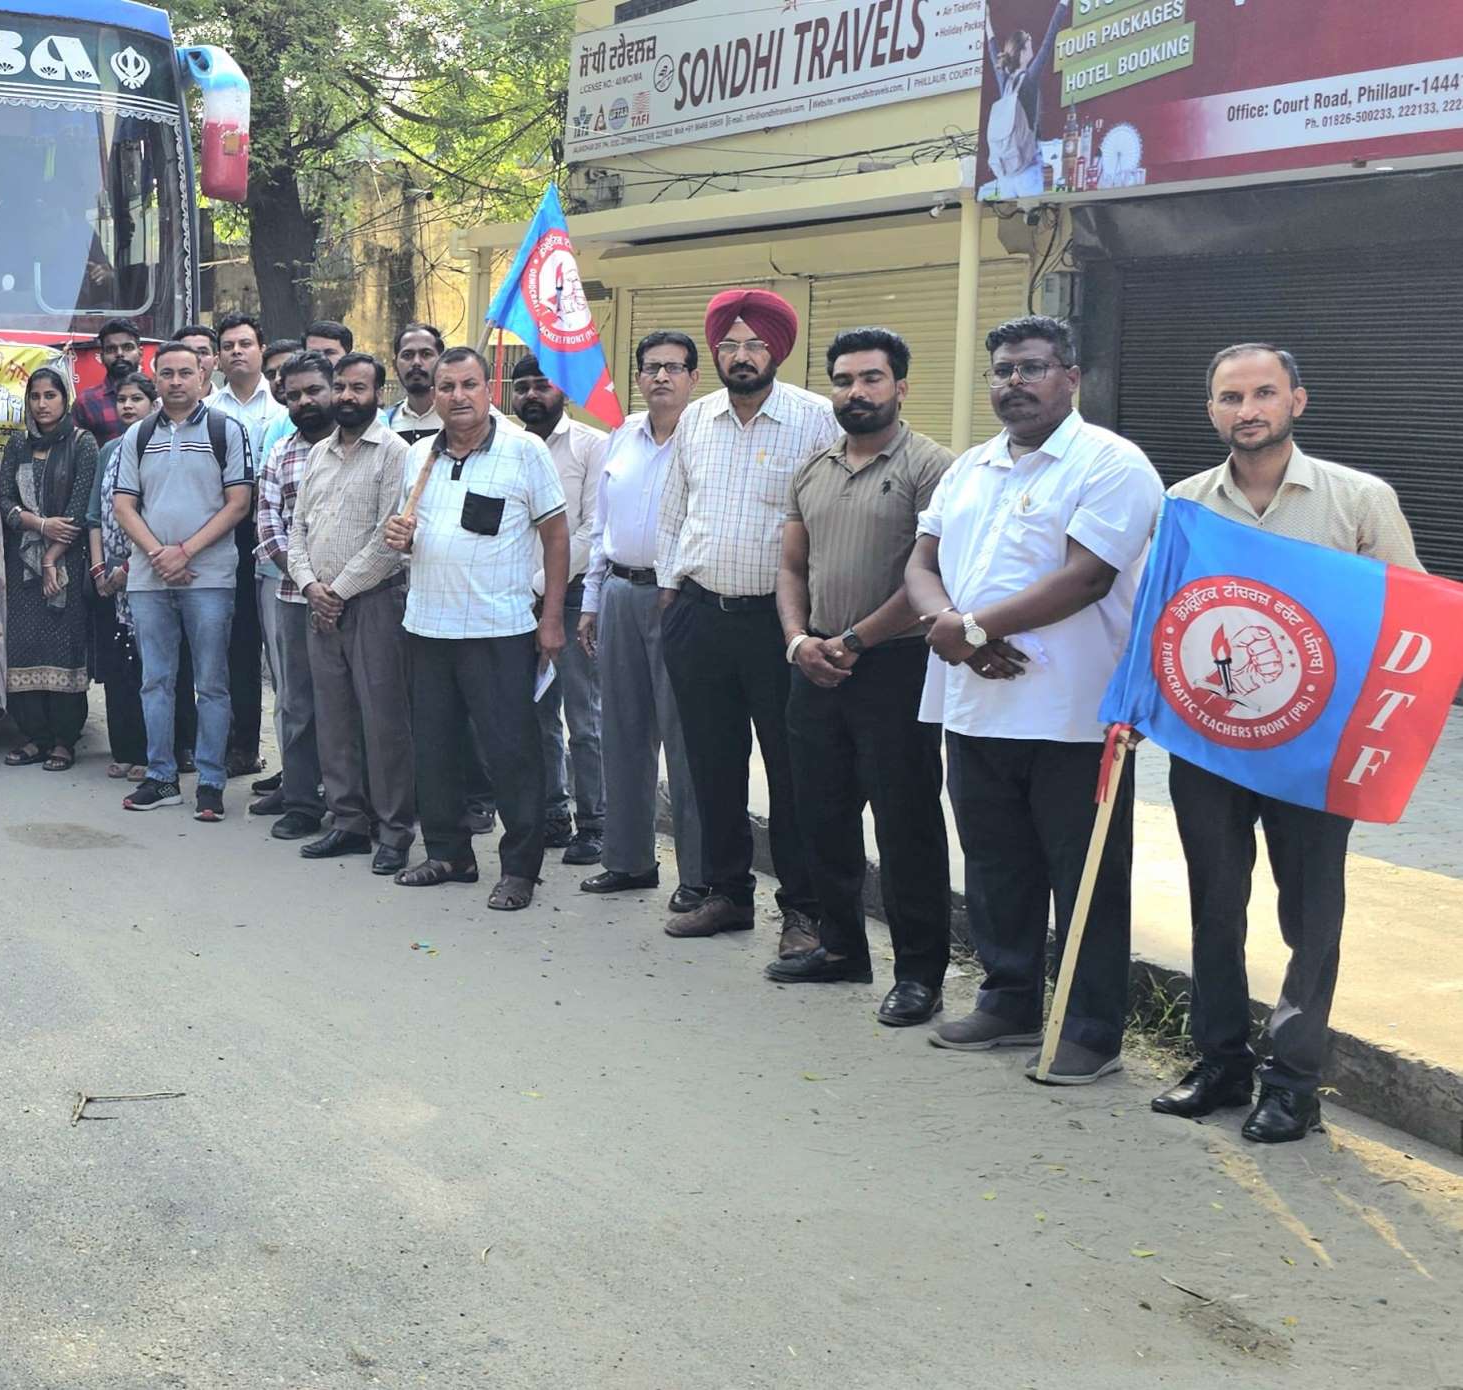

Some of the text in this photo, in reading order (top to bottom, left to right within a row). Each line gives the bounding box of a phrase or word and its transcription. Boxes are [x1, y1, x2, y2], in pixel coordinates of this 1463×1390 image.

[1057, 0, 1185, 60] TOUR PACKAGES
[674, 0, 928, 110] SONDHI TRAVELS
[1065, 34, 1190, 93] HOTEL BOOKING
[631, 114, 649, 127] TAFI
[1227, 72, 1463, 121] Office: Court Road, Phillaur-1444
[1305, 118, 1319, 129] Ph.
[1322, 107, 1395, 127] 01826-500233,
[1398, 102, 1439, 118] 222133,
[563, 333, 584, 345] FRONT
[1297, 627, 1324, 674] (ਪੰਜਾਬ)
[1162, 642, 1315, 738] DEMOCRATIC TEACHERS FRONT (PB.)
